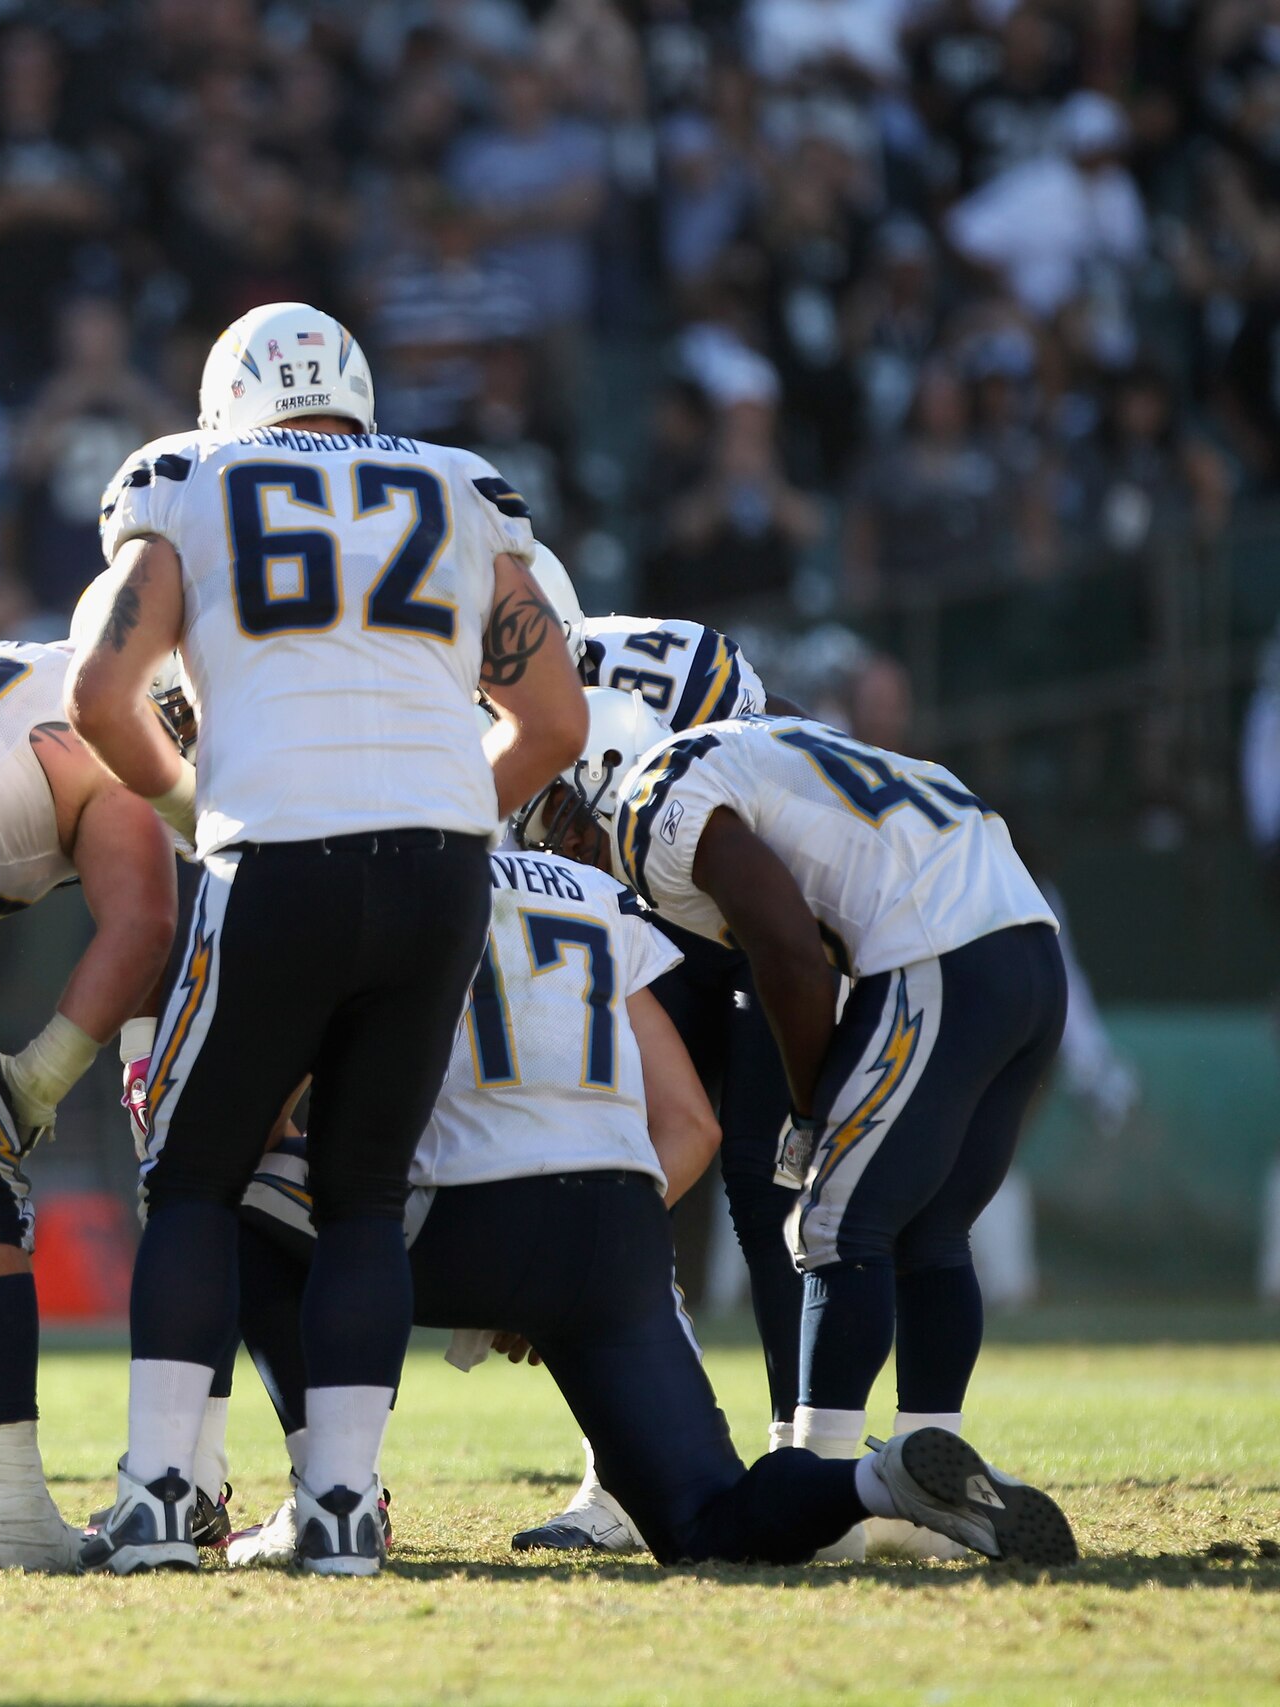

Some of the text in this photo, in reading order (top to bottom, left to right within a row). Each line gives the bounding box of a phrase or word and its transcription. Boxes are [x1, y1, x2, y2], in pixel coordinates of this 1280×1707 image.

[276, 394, 332, 412] CHARGERS
[221, 459, 460, 646] 62
[609, 629, 690, 714] 84
[465, 906, 619, 1093] 17
